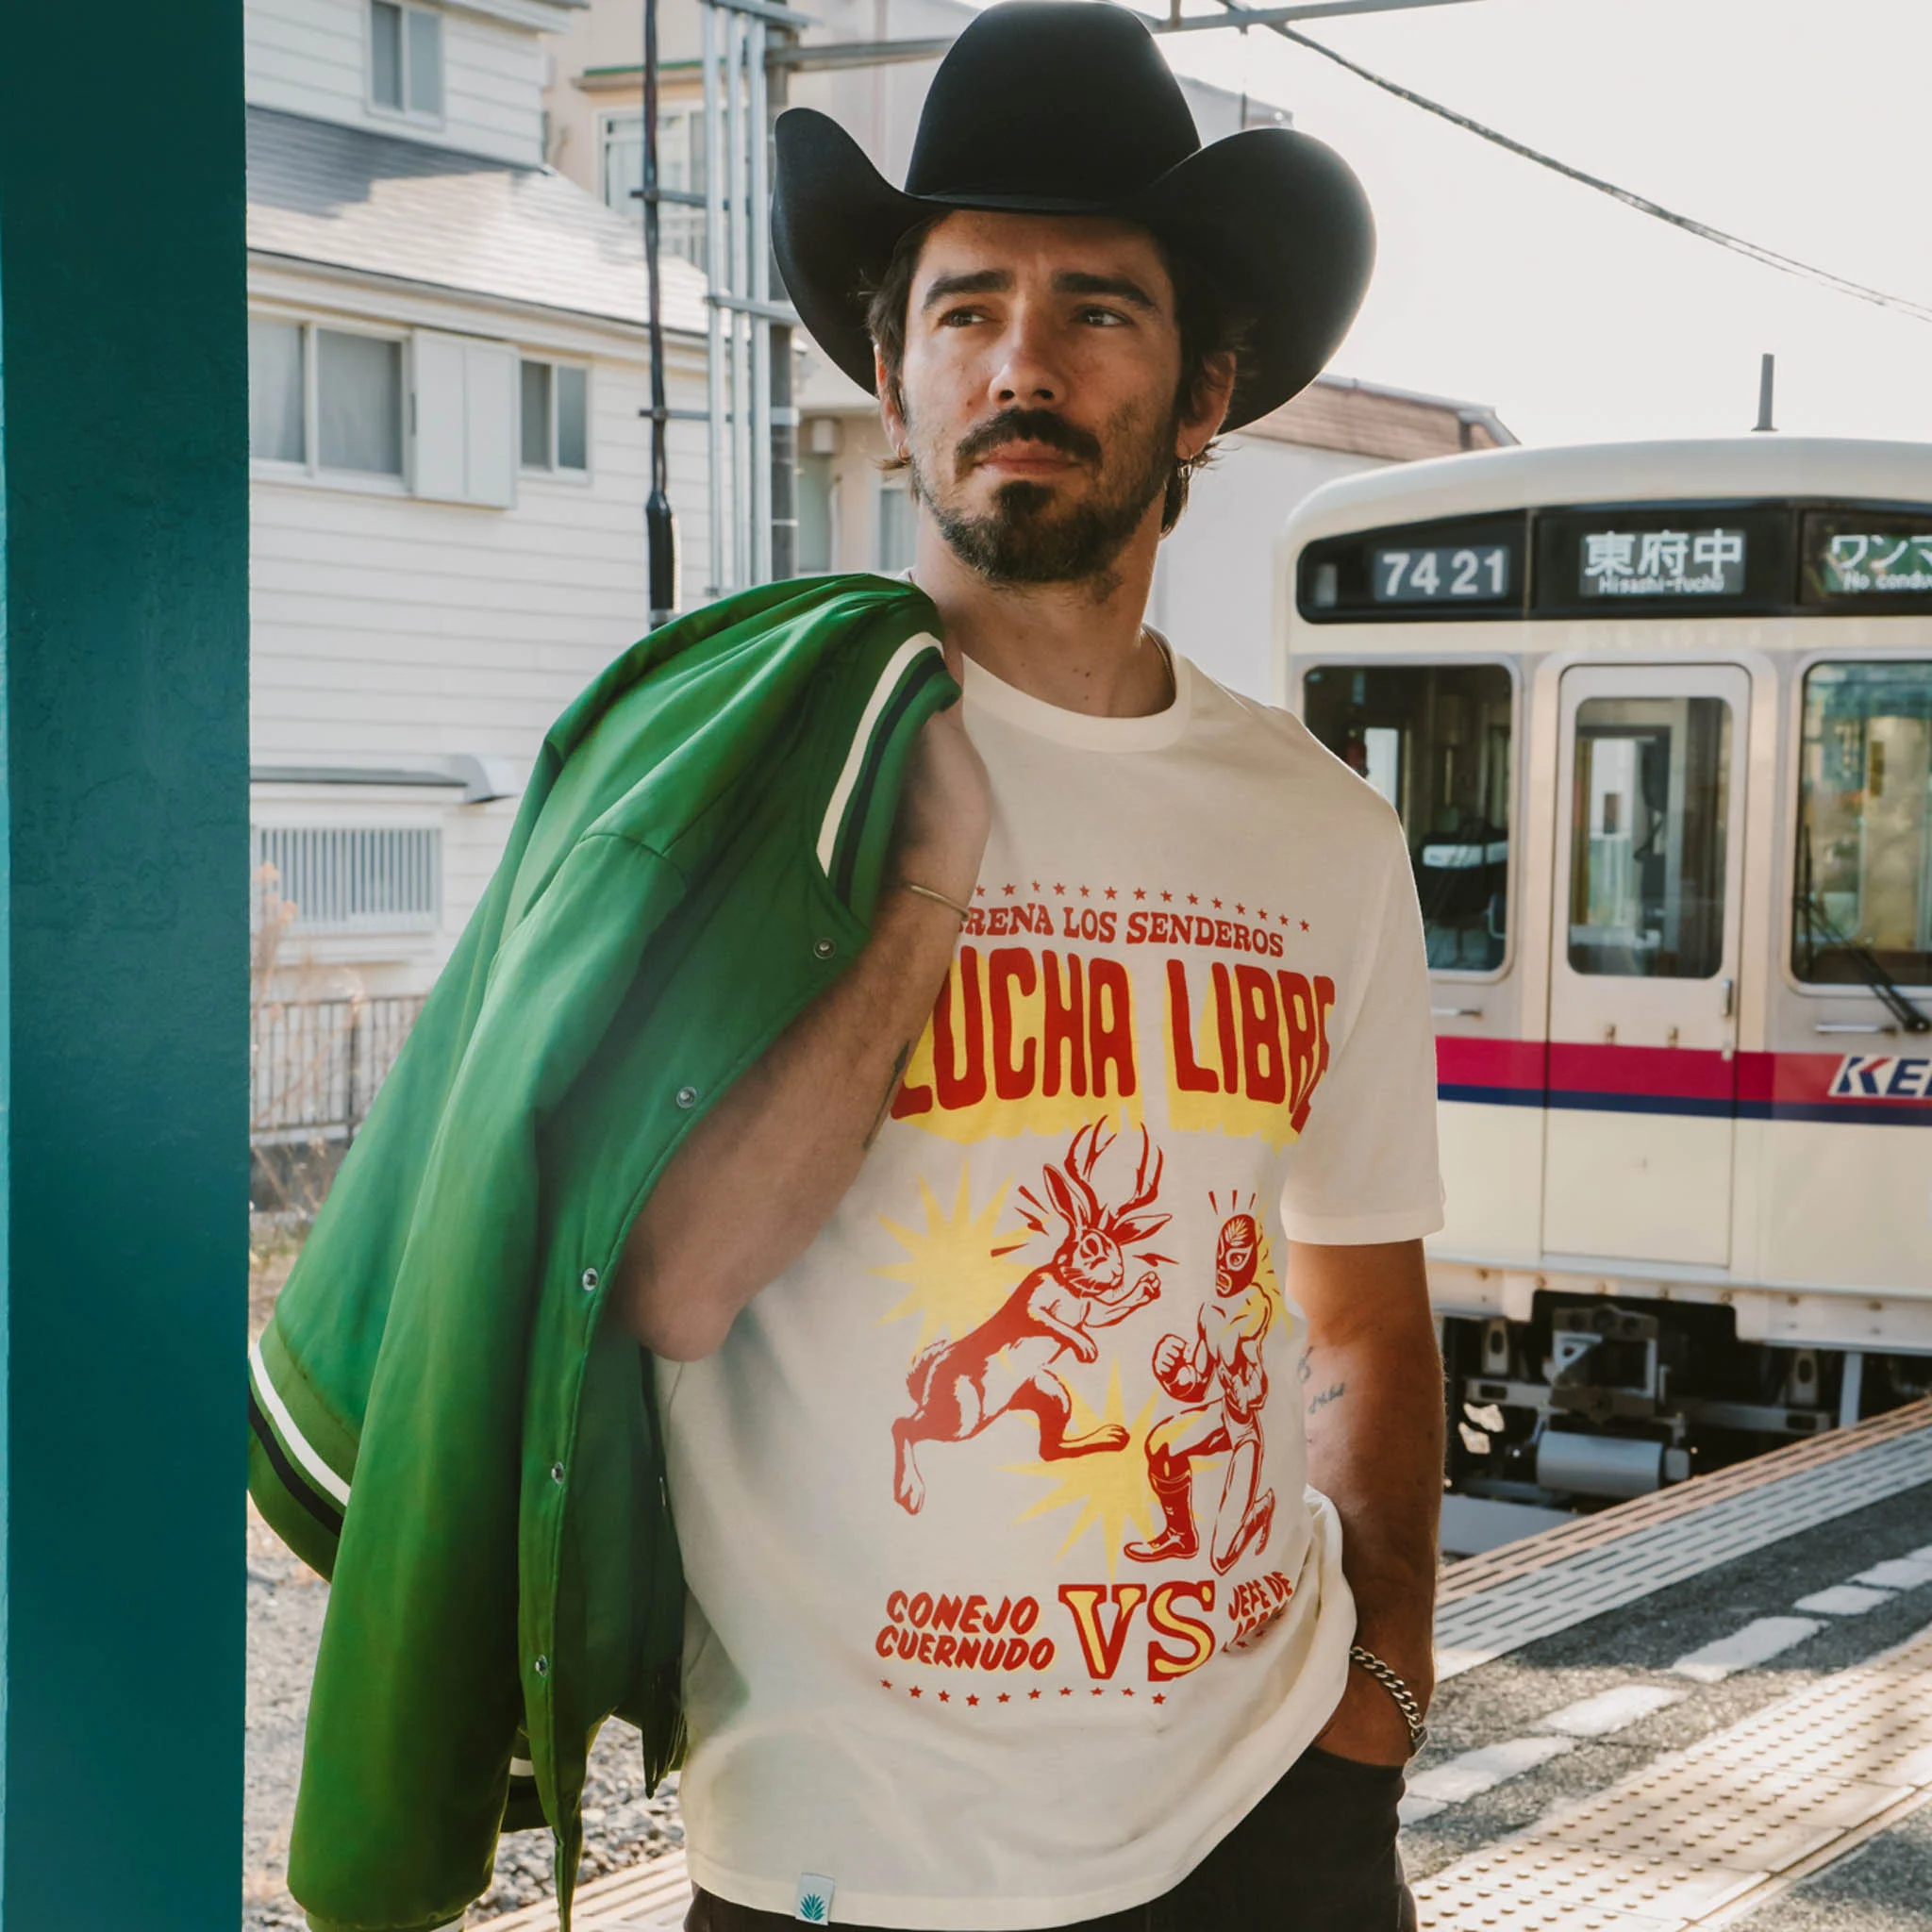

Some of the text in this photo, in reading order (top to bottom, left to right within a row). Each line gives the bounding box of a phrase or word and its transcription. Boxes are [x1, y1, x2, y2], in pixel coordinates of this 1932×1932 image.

[1585, 528, 1742, 576] 東府中
[958, 903, 1284, 958] RENA LOS SENDEROS
[887, 1591, 1040, 1635] CONEJO
[1228, 1571, 1293, 1621] JEFE DE
[875, 1624, 1055, 1671] CUERNUDO
[1058, 1579, 1215, 1682] VS
